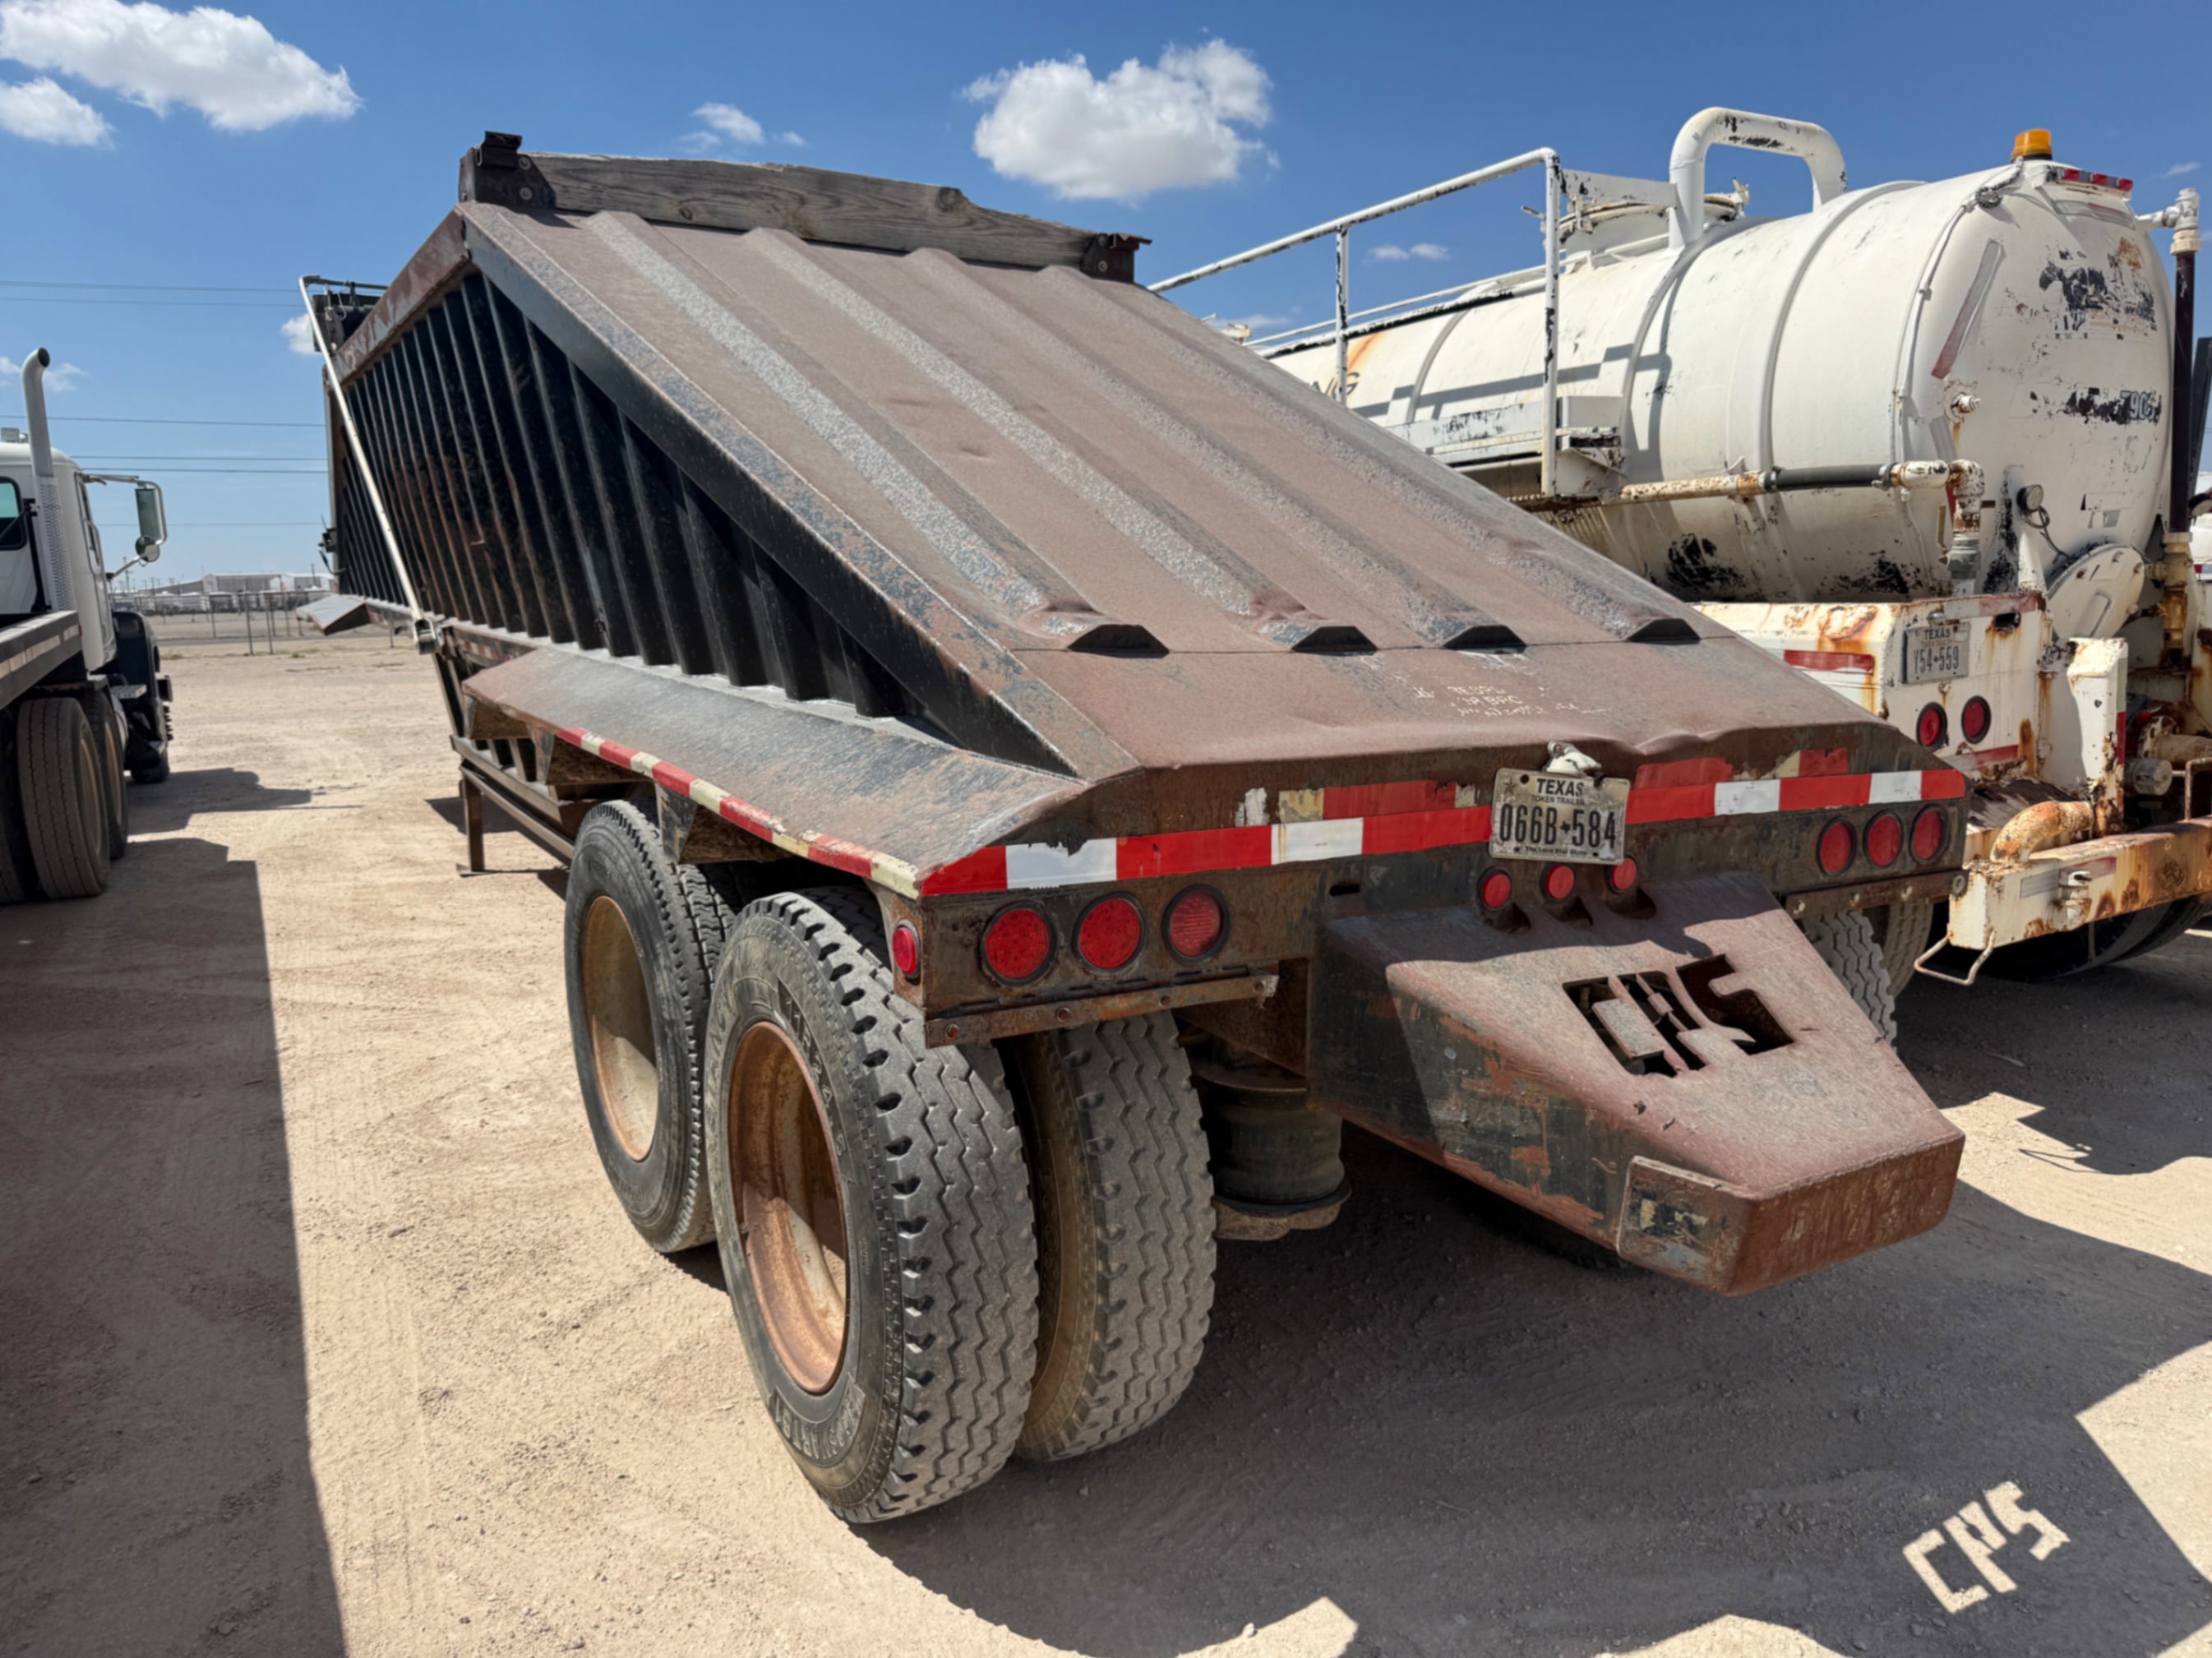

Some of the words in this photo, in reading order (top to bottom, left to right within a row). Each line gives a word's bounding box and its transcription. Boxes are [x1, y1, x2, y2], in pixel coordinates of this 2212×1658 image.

[1924, 627, 1951, 640] TEXAS
[1536, 778, 1584, 797] TEXAS
[1531, 795, 1556, 803] TOKEN
[1557, 796, 1585, 806] TRAILER
[1562, 954, 1795, 1078] CPS
[1902, 1480, 2071, 1614] CPS
